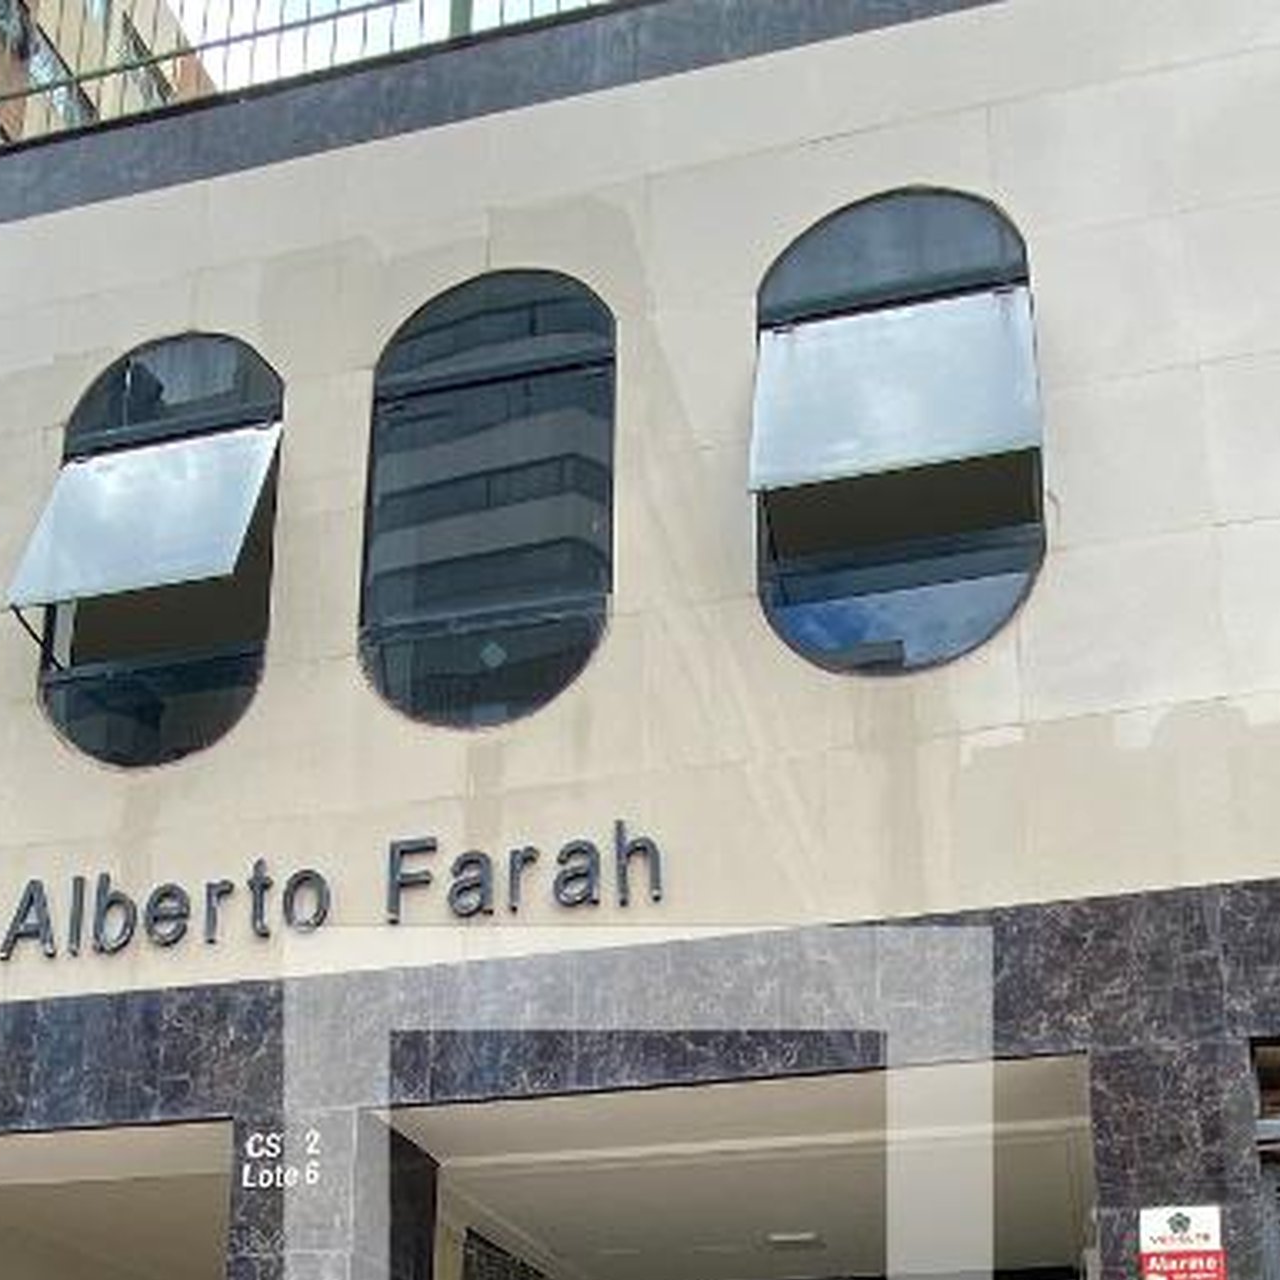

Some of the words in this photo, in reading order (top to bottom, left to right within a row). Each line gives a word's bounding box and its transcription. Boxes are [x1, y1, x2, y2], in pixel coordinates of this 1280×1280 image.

[0, 855, 332, 963] Alberto
[387, 820, 663, 925] Farah
[305, 1128, 320, 1155] 2
[242, 1163, 299, 1188] Lote
[305, 1160, 320, 1185] 6
